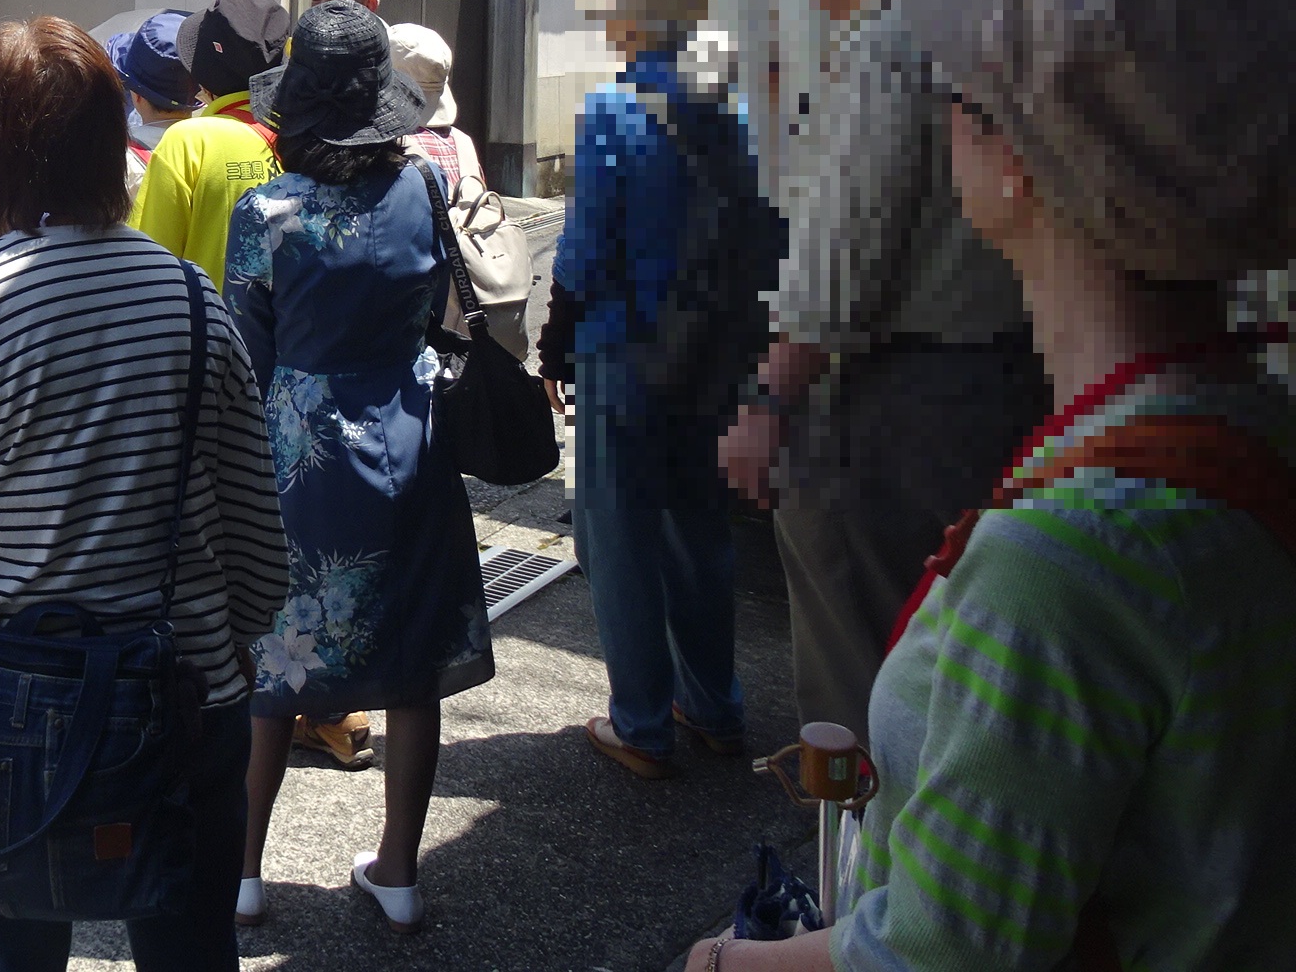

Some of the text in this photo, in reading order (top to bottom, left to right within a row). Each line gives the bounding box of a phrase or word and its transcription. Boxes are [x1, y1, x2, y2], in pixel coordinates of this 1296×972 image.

[226, 161, 265, 180] 三重県
[448, 247, 476, 311] OURDAN
